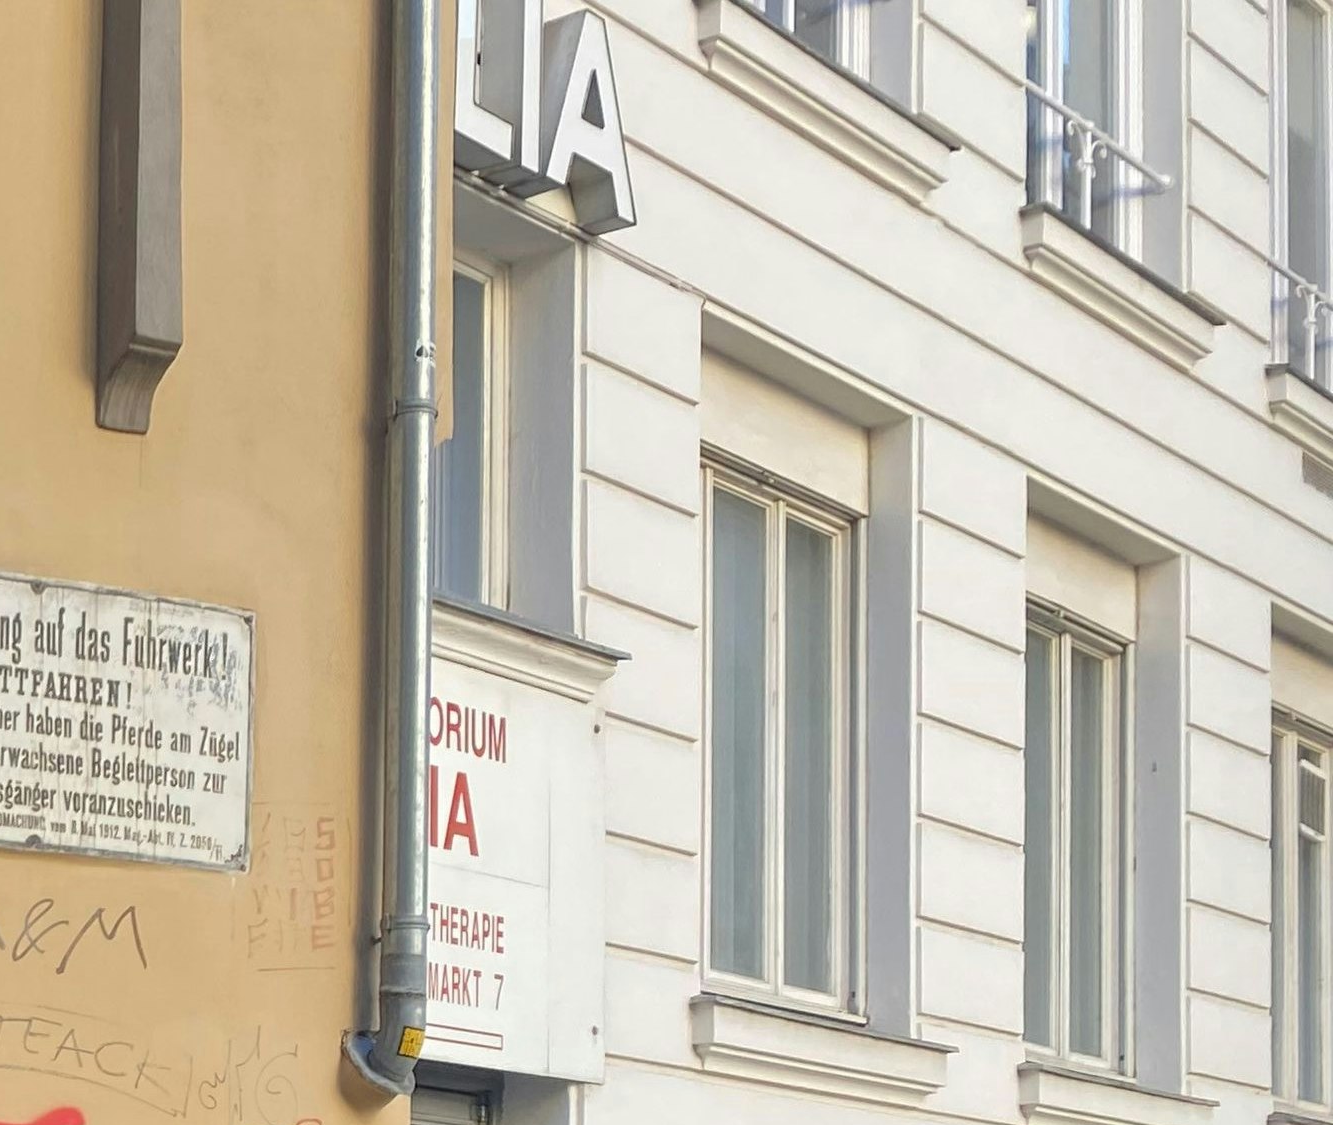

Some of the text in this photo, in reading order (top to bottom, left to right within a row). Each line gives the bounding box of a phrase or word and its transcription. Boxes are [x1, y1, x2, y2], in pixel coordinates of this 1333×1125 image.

[35, 607, 65, 658] auf
[76, 611, 111, 663] das
[26, 703, 72, 738] haben
[80, 711, 103, 743] die
[112, 714, 163, 750] Pferde
[171, 730, 192, 753] am
[199, 726, 240, 763] Zügel
[92, 748, 195, 790] Begleitperson
[203, 772, 227, 794] zur
[429, 902, 505, 955] THERAPIE
[494, 973, 504, 1011] 7
